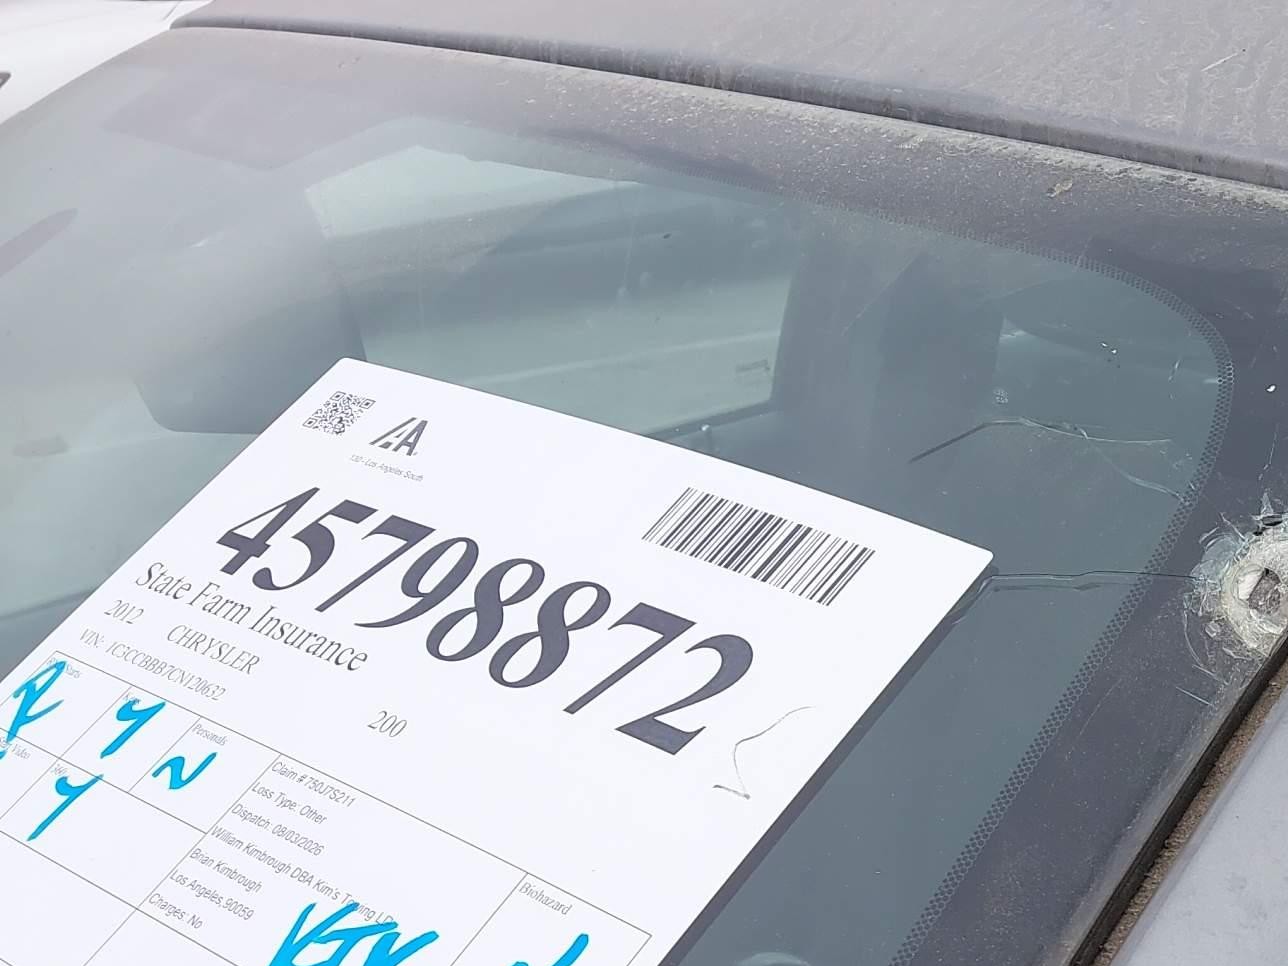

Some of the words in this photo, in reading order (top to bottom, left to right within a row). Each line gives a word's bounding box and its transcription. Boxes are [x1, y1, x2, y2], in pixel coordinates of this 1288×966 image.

[104, 599, 144, 624] 2012
[167, 625, 260, 675] CHRYSLER
[135, 561, 192, 600] State
[186, 581, 251, 625] Farm
[249, 605, 368, 671] Insurance
[216, 487, 753, 755] 45798872
[105, 641, 226, 701] 1C3CCBBB7CN120632
[192, 724, 228, 746] Personals
[367, 710, 407, 737] 200
[272, 762, 298, 781] Claim
[251, 781, 275, 800] Loss
[274, 792, 299, 811] Type:
[299, 805, 327, 825] Other
[231, 804, 272, 830] Dispatch:
[271, 824, 324, 856] 08/03/2026
[170, 869, 189, 886] Los
[189, 848, 215, 868] Brian
[213, 860, 263, 893] Kimbrough
[211, 826, 243, 850] William
[242, 843, 292, 874] Kimbrough
[290, 867, 315, 886] DBA
[312, 880, 341, 901] Kim's
[148, 893, 190, 920] Charges:
[187, 914, 204, 930] No
[519, 882, 573, 915] Biohazard
